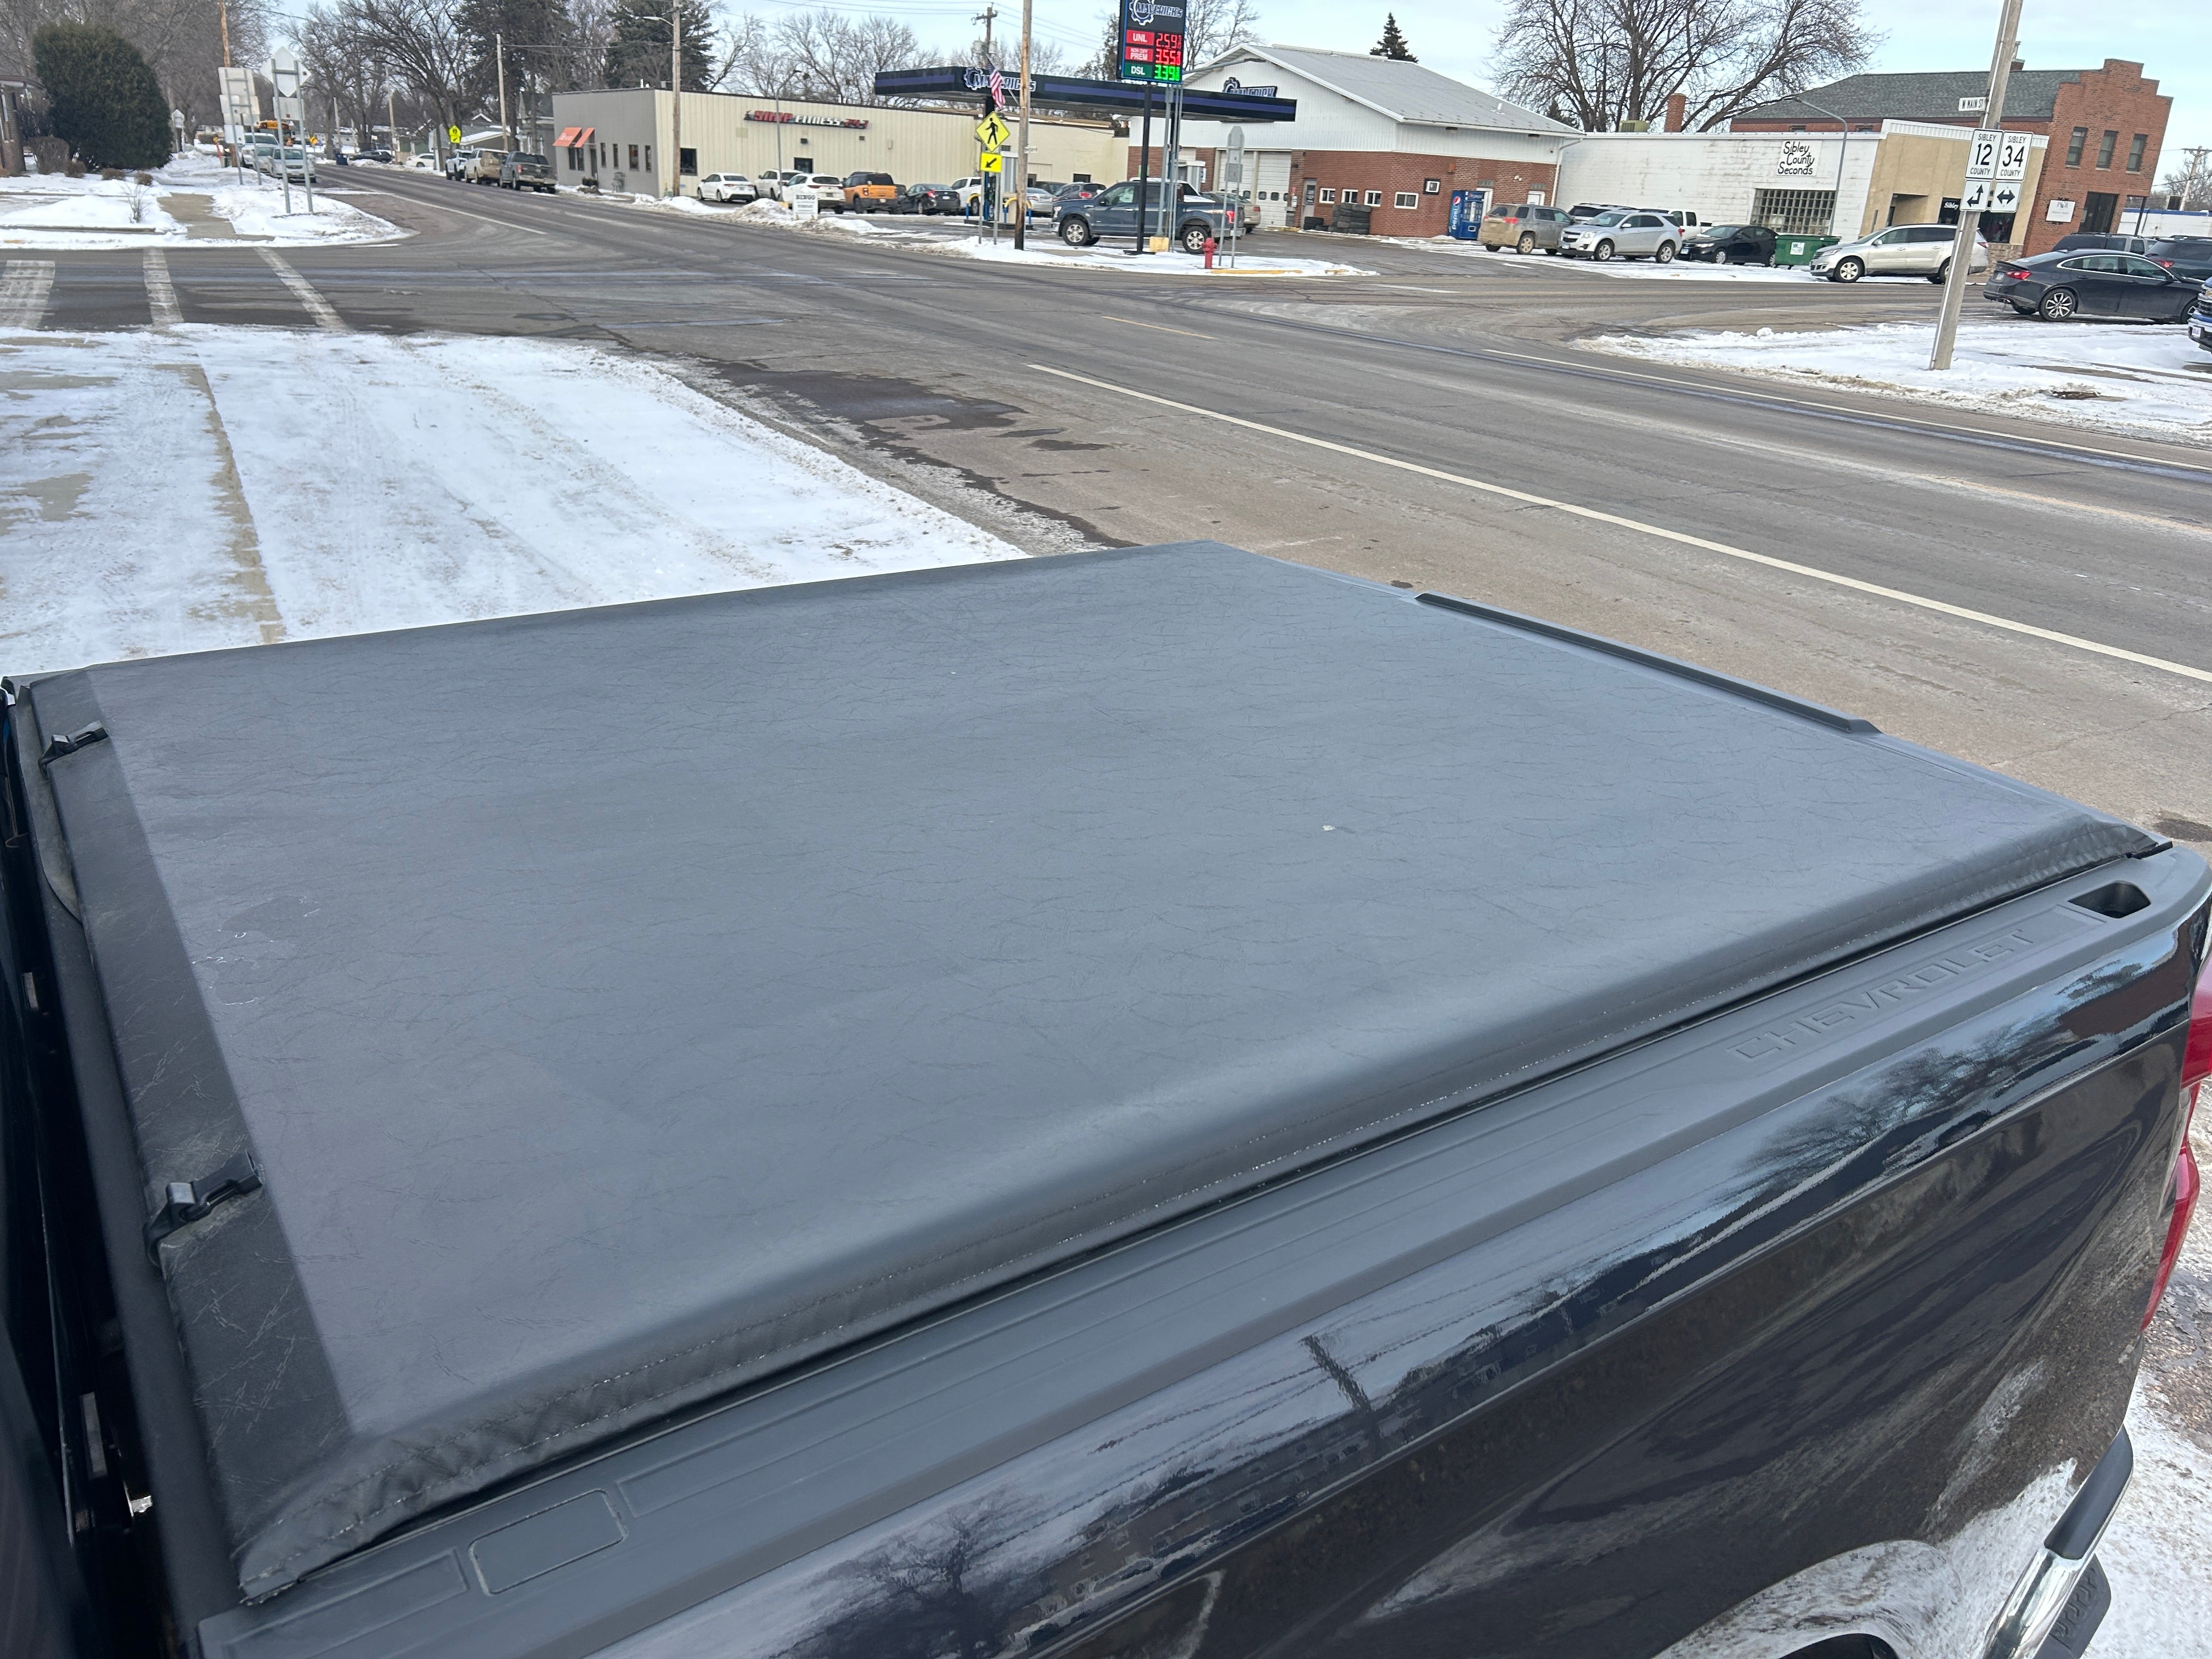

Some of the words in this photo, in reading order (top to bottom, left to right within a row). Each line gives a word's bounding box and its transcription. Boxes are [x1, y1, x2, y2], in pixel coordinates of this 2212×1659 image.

[1132, 33, 1148, 42] UNL
[1130, 52, 1148, 61] PREM
[1131, 66, 1146, 75] DSL
[1962, 100, 1966, 109] W
[1967, 99, 1978, 109] MAIN
[1978, 99, 1984, 108] ST
[1978, 133, 1997, 142] SIBLEY
[2008, 136, 2027, 144] SIBLEY
[1783, 141, 1810, 156] Sibley
[1975, 143, 1993, 165] 12
[2002, 145, 2025, 167] 34
[1787, 152, 1815, 167] County
[1778, 161, 1813, 174] Seconds
[1970, 167, 1991, 175] COUNTY
[1726, 928, 2034, 1062] CHEVROLET
